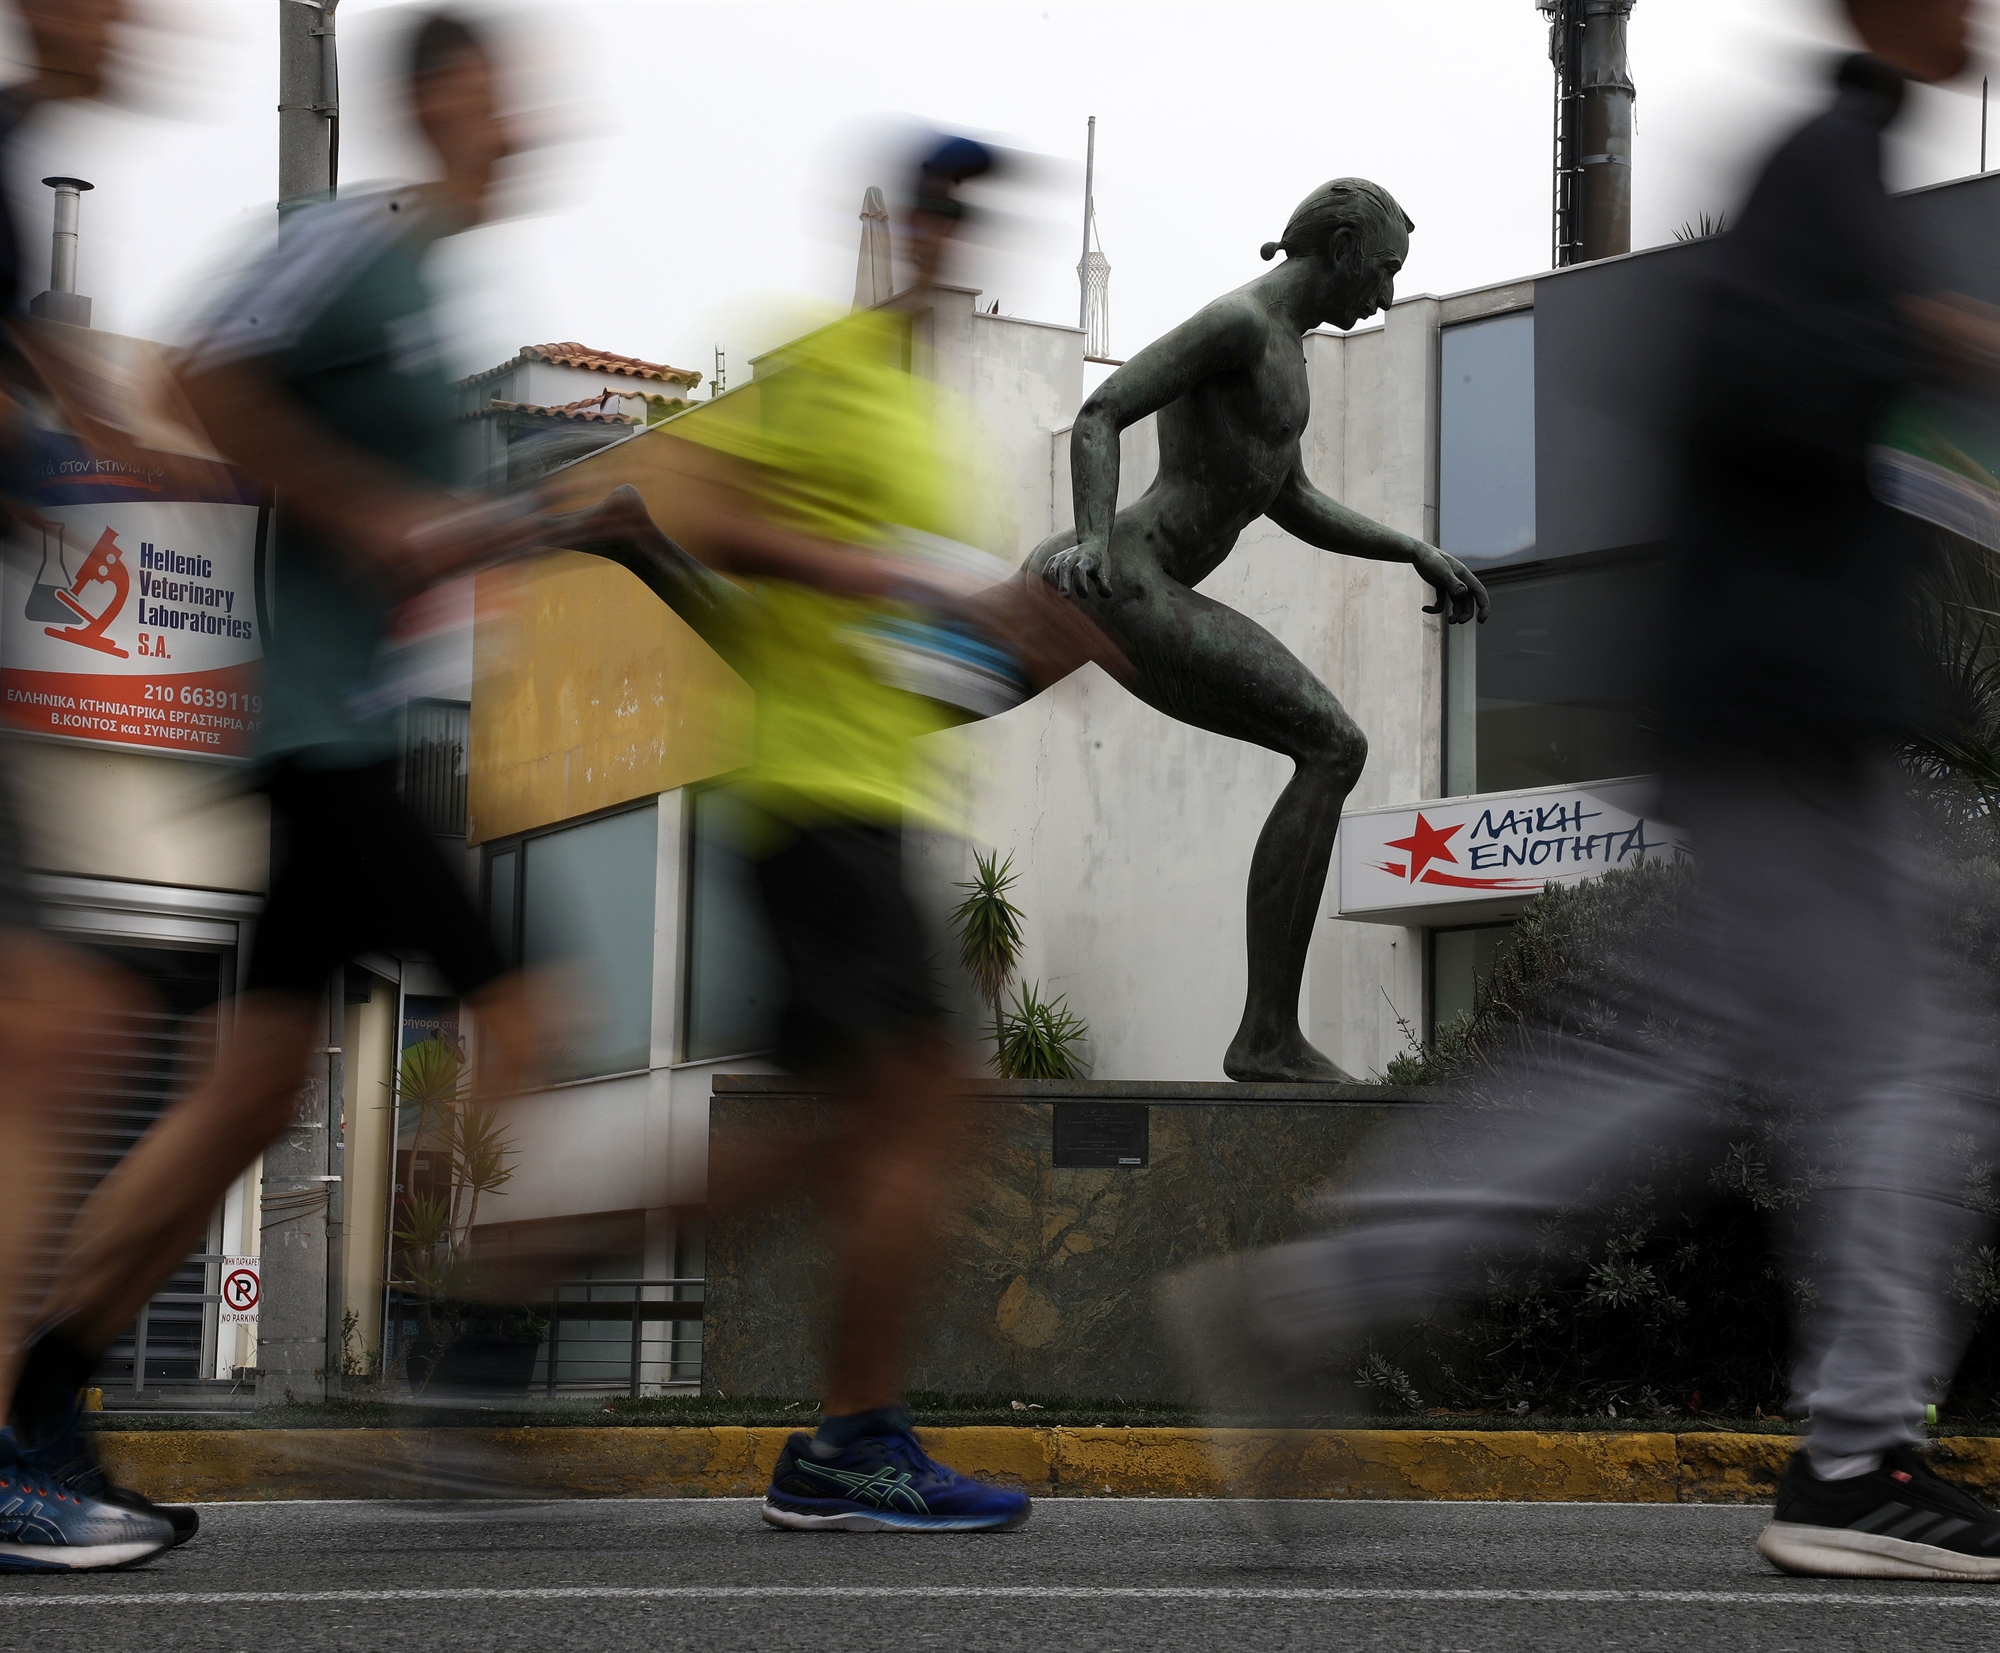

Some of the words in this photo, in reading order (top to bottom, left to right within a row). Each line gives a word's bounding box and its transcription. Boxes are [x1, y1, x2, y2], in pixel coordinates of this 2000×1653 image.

[140, 542, 212, 578] Hellenic
[139, 570, 235, 613] Veterinary
[138, 598, 252, 640] Laboratories
[138, 632, 171, 659] S.A.
[7, 688, 76, 710] ΕΛΛΗΝΙΚΑ
[79, 698, 166, 721] ΚΤΗΝΙΑΤΡΙΚΑ
[169, 710, 243, 731] ΕΡΓΑΣΤΗΡΙΑ
[144, 684, 174, 702] 210
[180, 685, 263, 714] 6639119
[51, 712, 118, 732] Β.ΚΟΝΤΟΣ
[120, 723, 141, 735] και
[143, 724, 221, 745] ΣΥΝΕΡΓΑΤΕΣ
[1468, 818, 1669, 871] ΕΝΟΤΗΤΑ
[222, 1314, 231, 1322] NO
